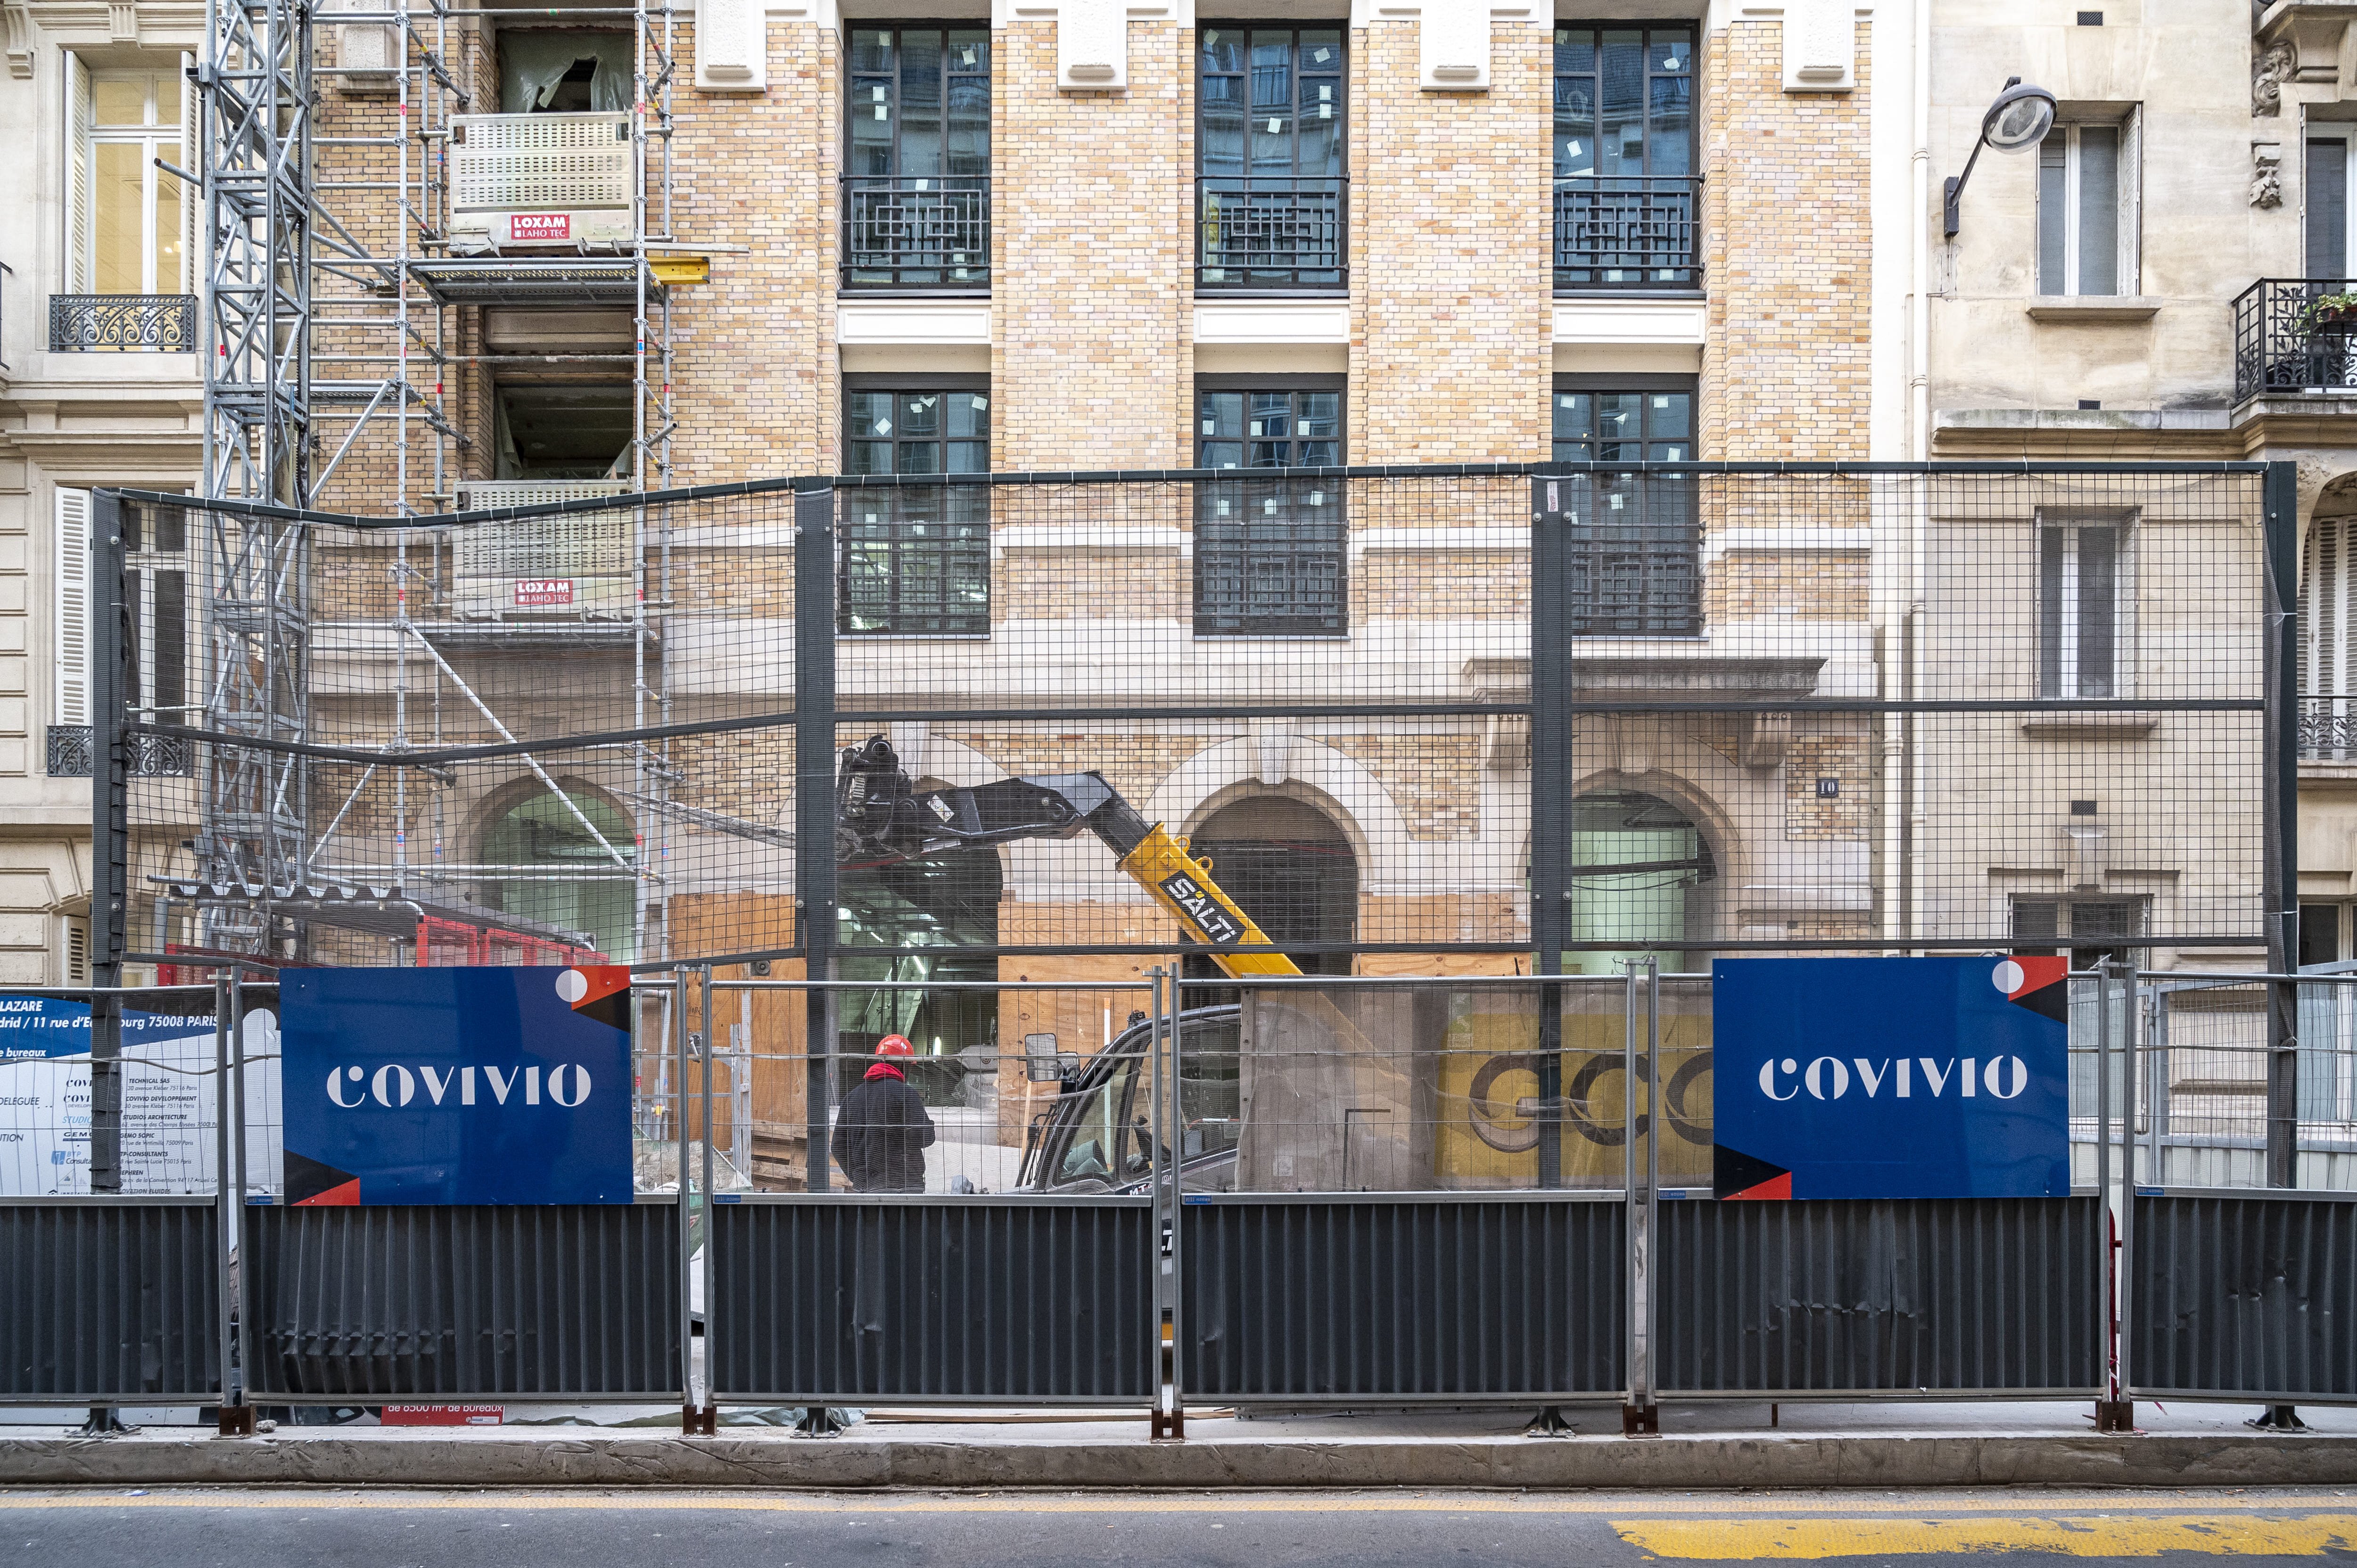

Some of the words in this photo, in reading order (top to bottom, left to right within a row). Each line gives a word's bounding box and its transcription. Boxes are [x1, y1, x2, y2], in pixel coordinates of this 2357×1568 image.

[514, 217, 566, 228] LOXAM
[550, 229, 565, 237] TEC
[519, 582, 569, 593] LOXAM
[526, 594, 551, 602] LAHO
[553, 594, 569, 602] TEC
[1820, 781, 1835, 794] 10
[34, 1017, 46, 1028] 11
[49, 1019, 69, 1028] rue
[148, 1016, 184, 1027] 75008
[6, 1047, 47, 1057] bureaux
[1759, 1055, 2027, 1101] COVIVIO
[326, 1064, 592, 1108] COVIVIO
